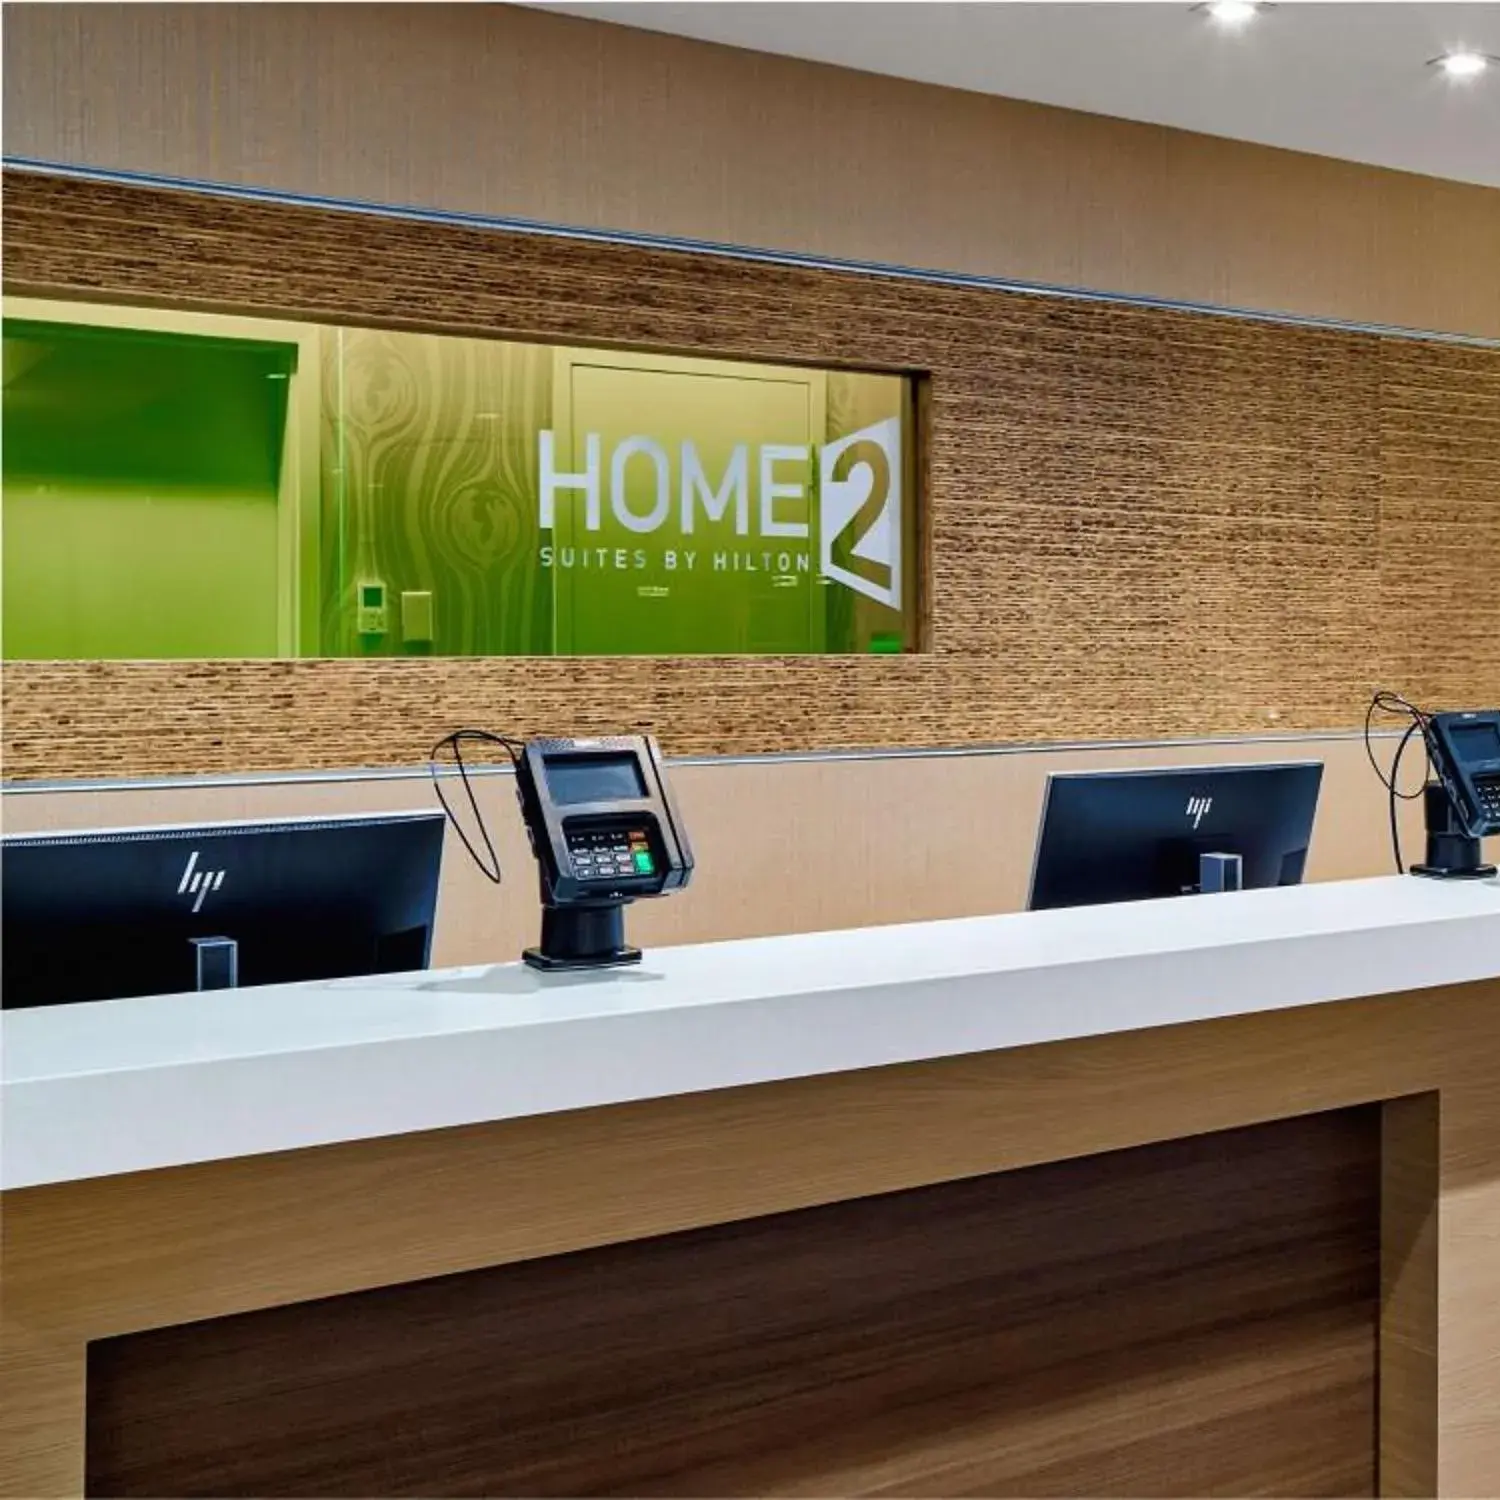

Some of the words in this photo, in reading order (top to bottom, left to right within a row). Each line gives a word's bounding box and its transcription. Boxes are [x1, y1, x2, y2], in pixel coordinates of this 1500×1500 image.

[539, 546, 647, 570] SUITES
[664, 550, 697, 571] BY
[713, 551, 810, 573] HILTON
